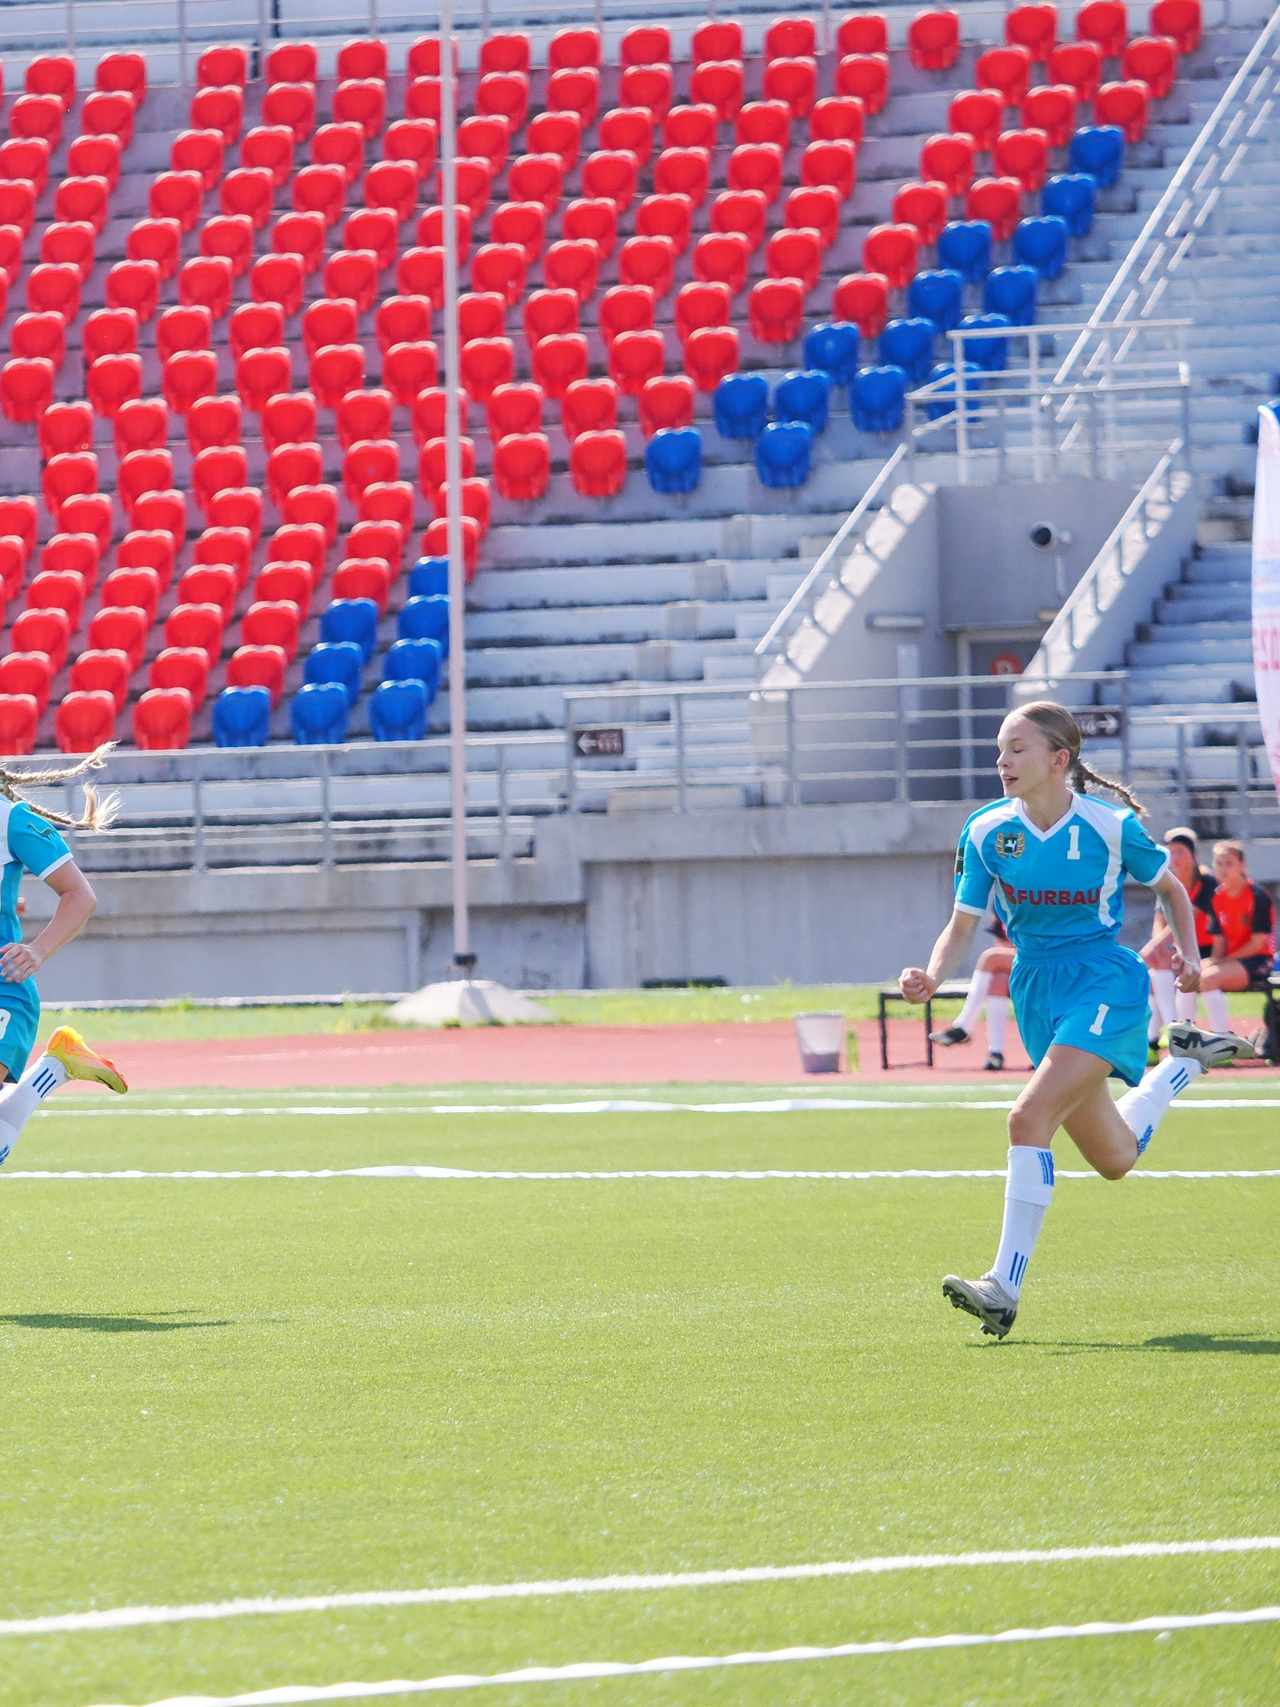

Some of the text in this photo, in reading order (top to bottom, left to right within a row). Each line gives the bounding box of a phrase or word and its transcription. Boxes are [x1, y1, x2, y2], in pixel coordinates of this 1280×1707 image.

[1067, 825, 1081, 860] 1
[1017, 888, 1101, 906] FURBAU
[1089, 1003, 1110, 1036] 1
